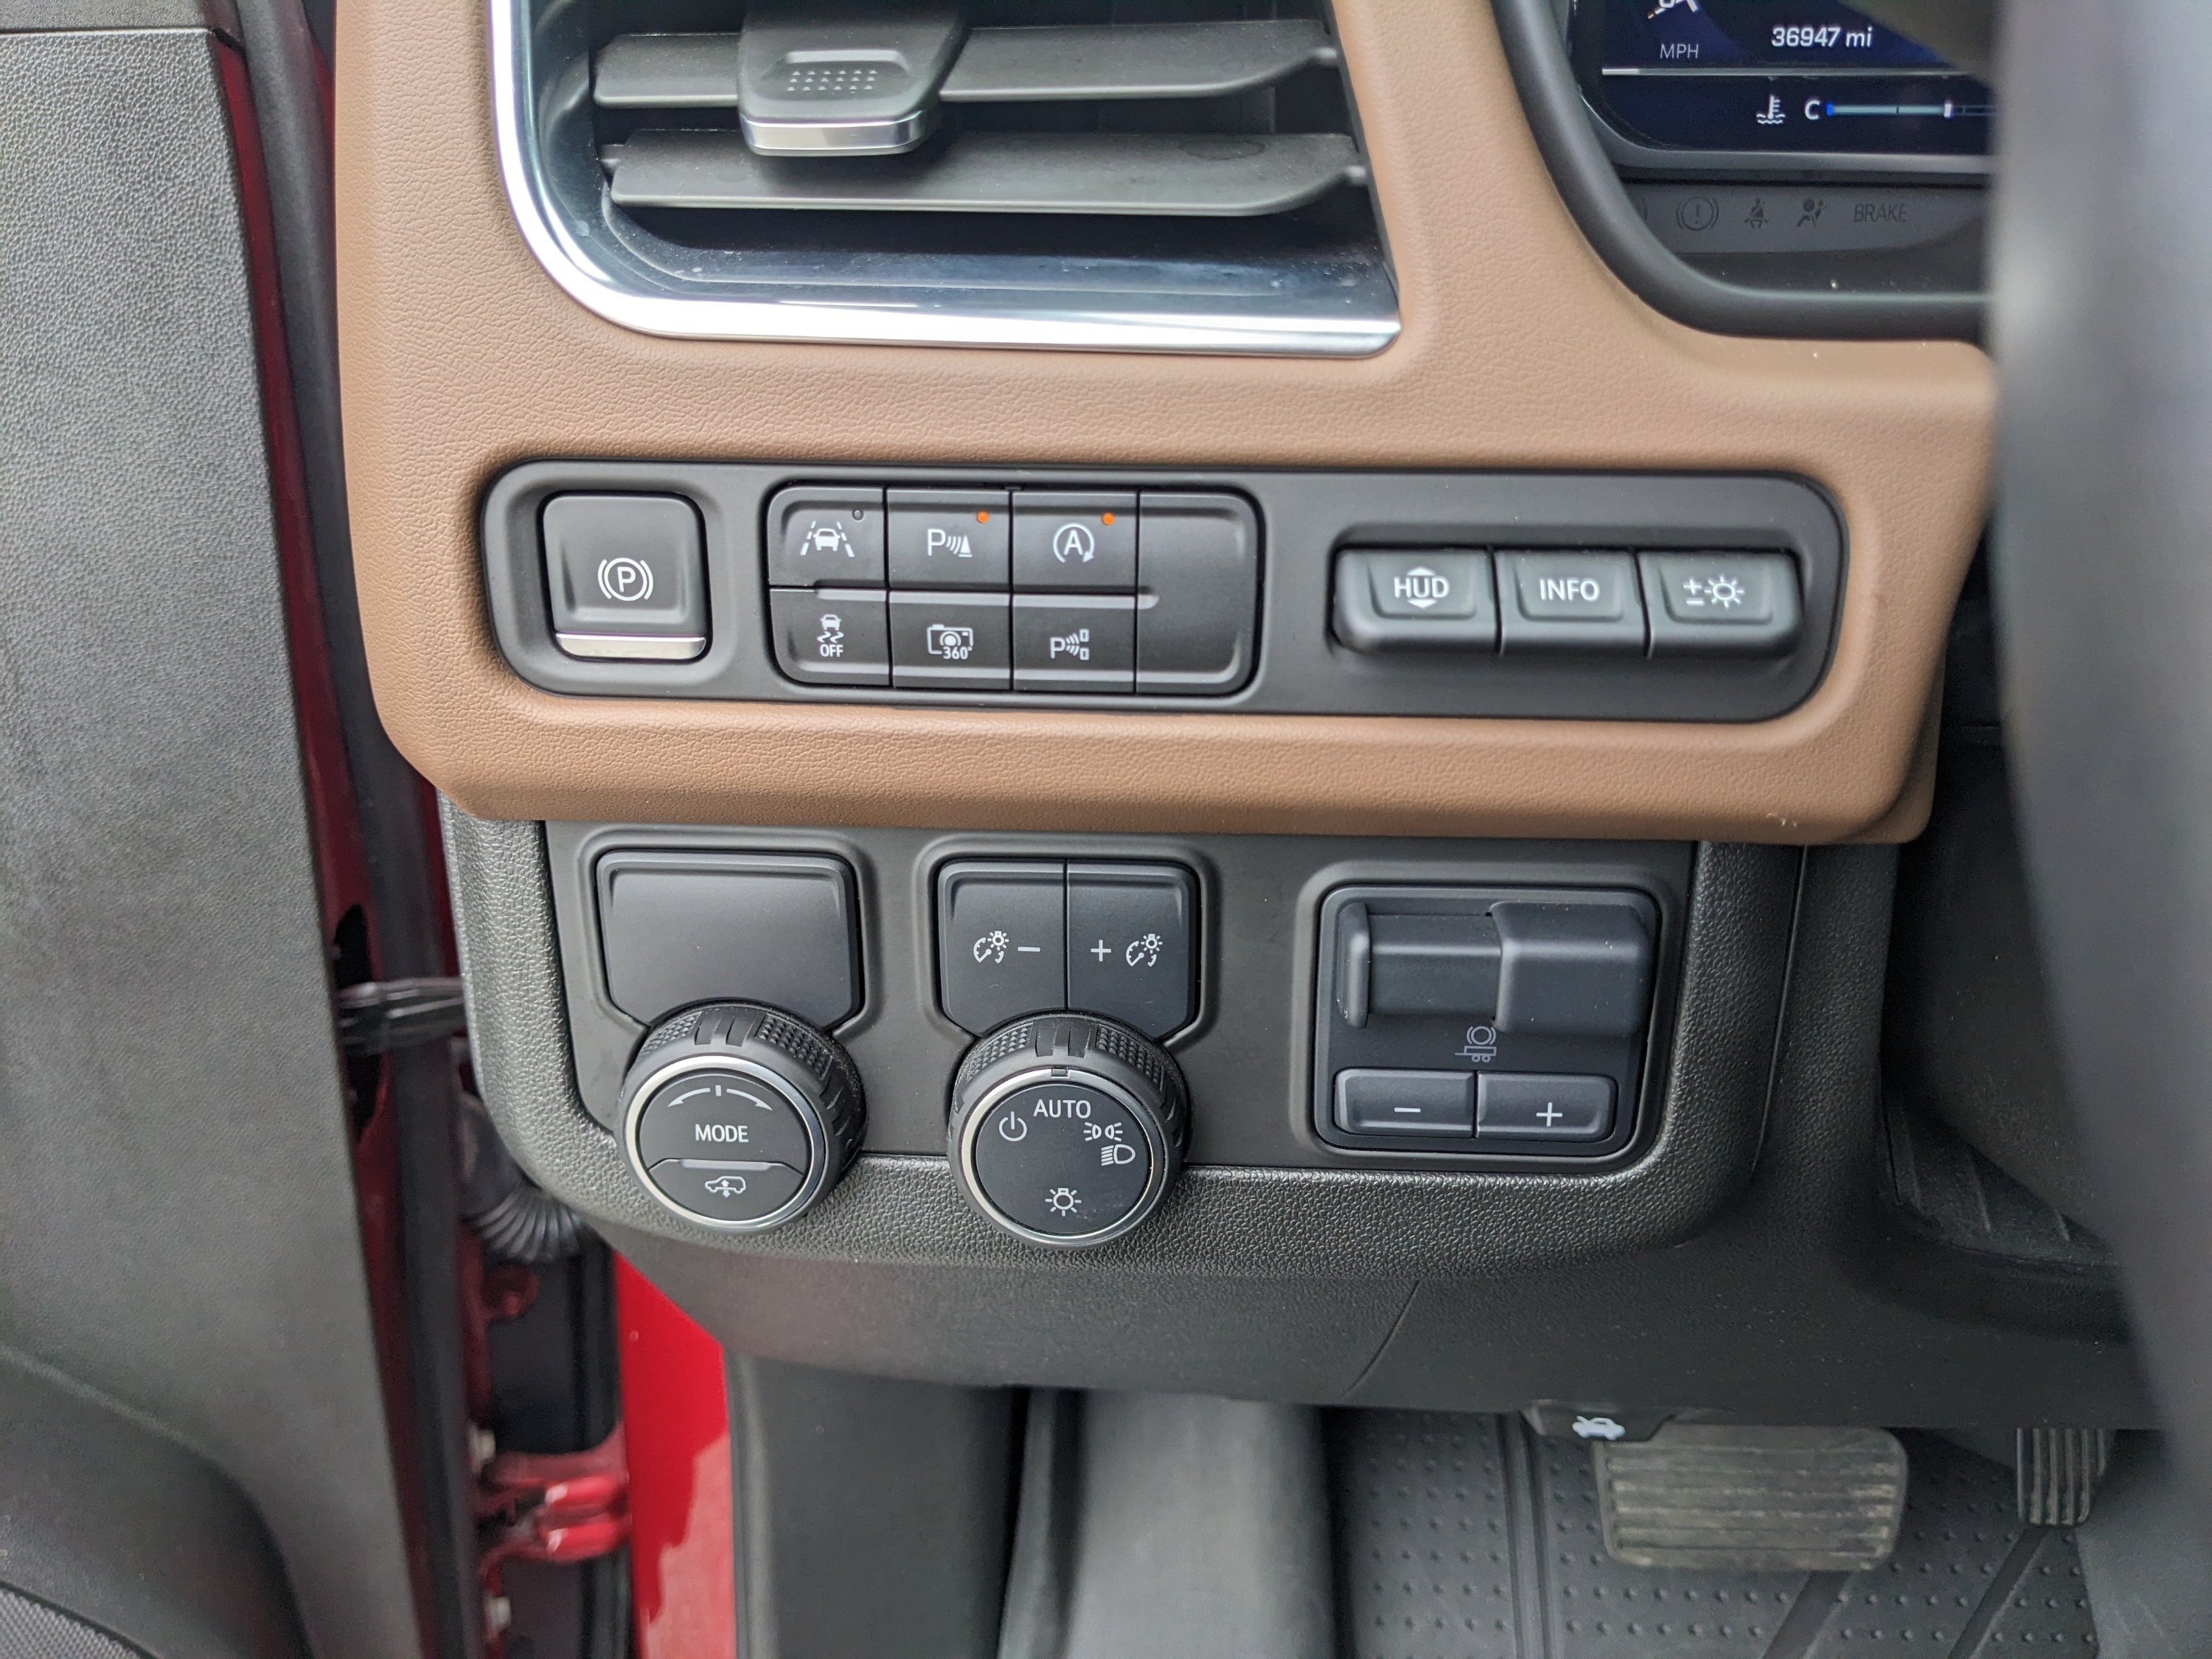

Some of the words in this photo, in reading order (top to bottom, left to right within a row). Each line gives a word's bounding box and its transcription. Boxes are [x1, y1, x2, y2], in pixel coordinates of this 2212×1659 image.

[1771, 27, 1839, 48] 36947
[1845, 27, 1873, 47] mi
[1659, 44, 1699, 59] MPH
[1804, 100, 1820, 120] C
[1854, 203, 1908, 222] BRAKE
[928, 529, 945, 557] P
[1063, 530, 1084, 555] A
[617, 566, 636, 592] P
[1394, 577, 1450, 599] HUD
[1539, 580, 1600, 601] INFO
[819, 644, 844, 658] OFF
[1050, 638, 1065, 659] P
[1034, 1099, 1091, 1119] AUTO
[695, 1124, 749, 1144] MODE
